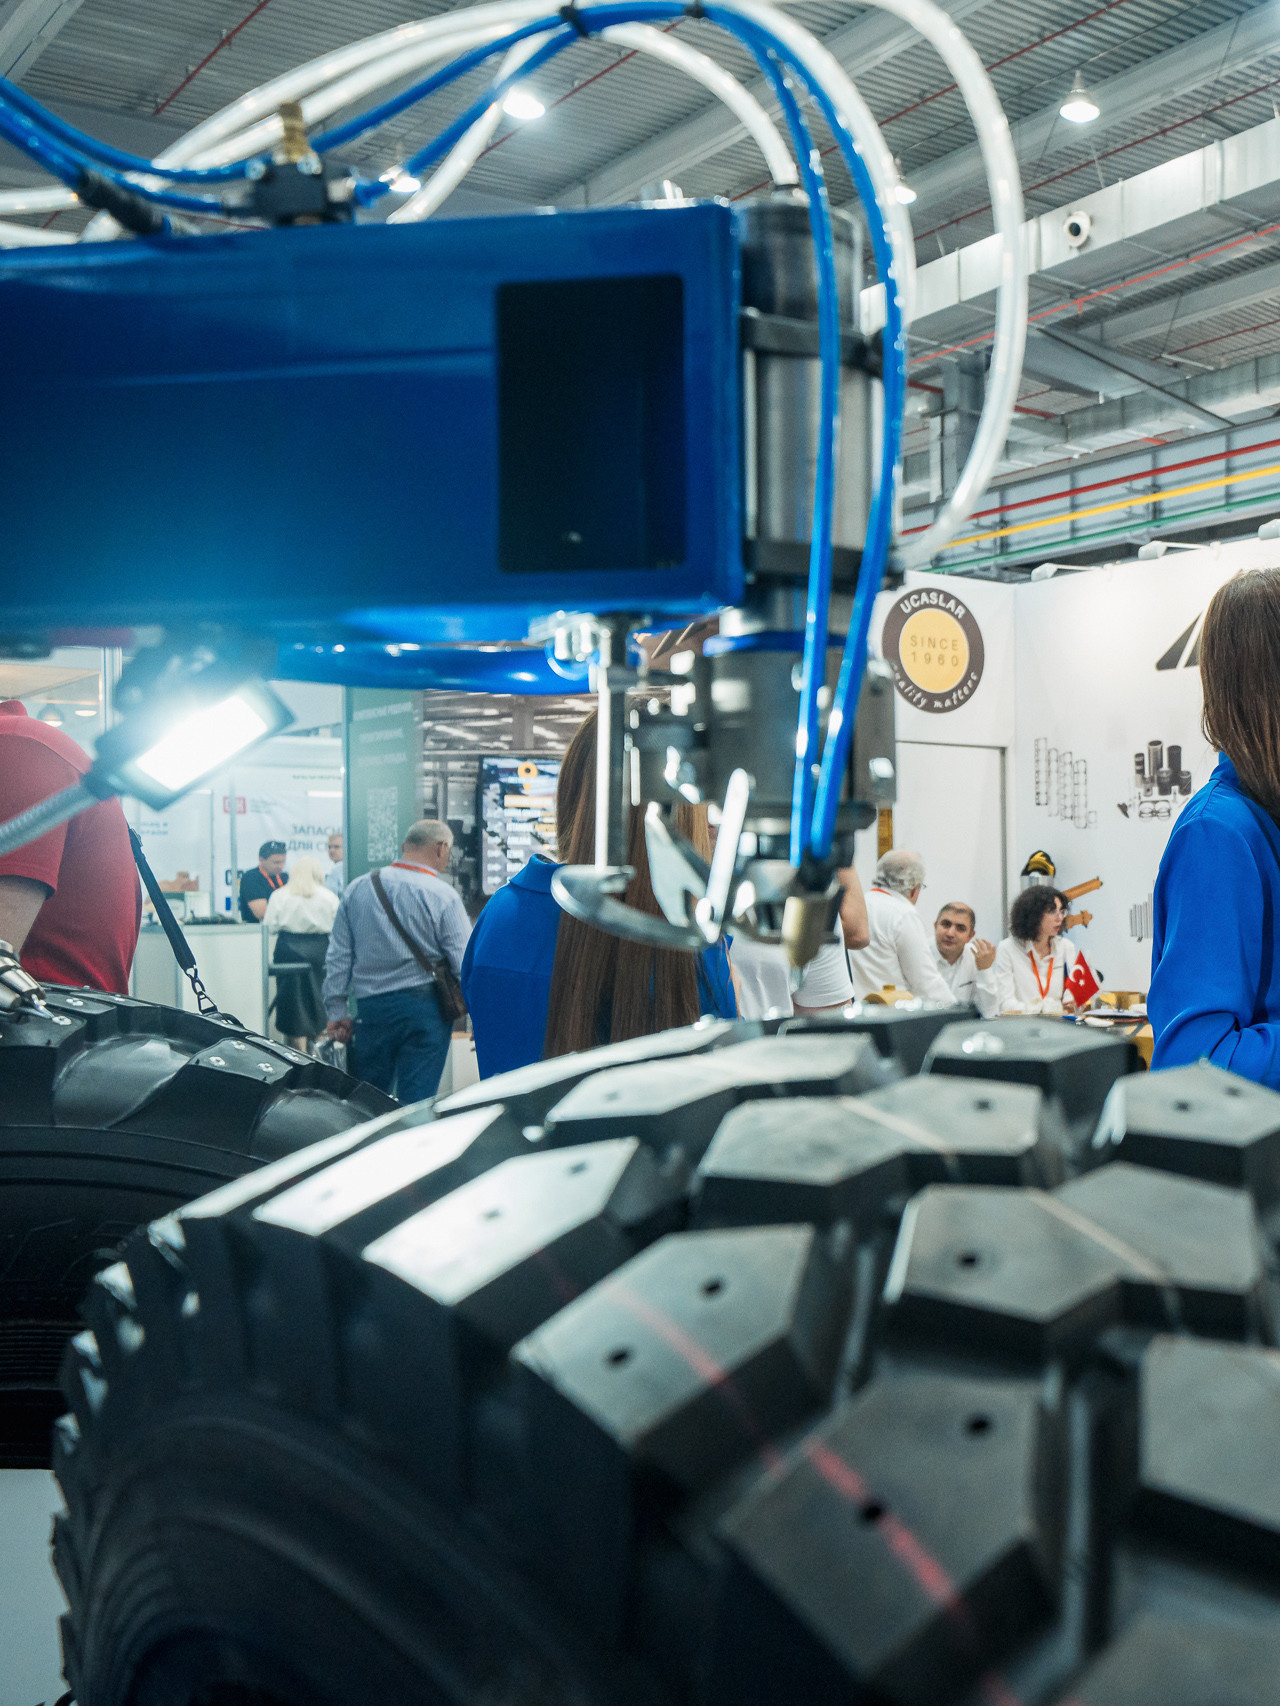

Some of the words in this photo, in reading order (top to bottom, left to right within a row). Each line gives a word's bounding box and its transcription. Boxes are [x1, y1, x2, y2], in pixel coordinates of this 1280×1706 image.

[900, 591, 967, 619] UCASLAR
[910, 634, 959, 651] SINCE
[911, 651, 959, 667] 1960
[933, 671, 978, 709] matters
